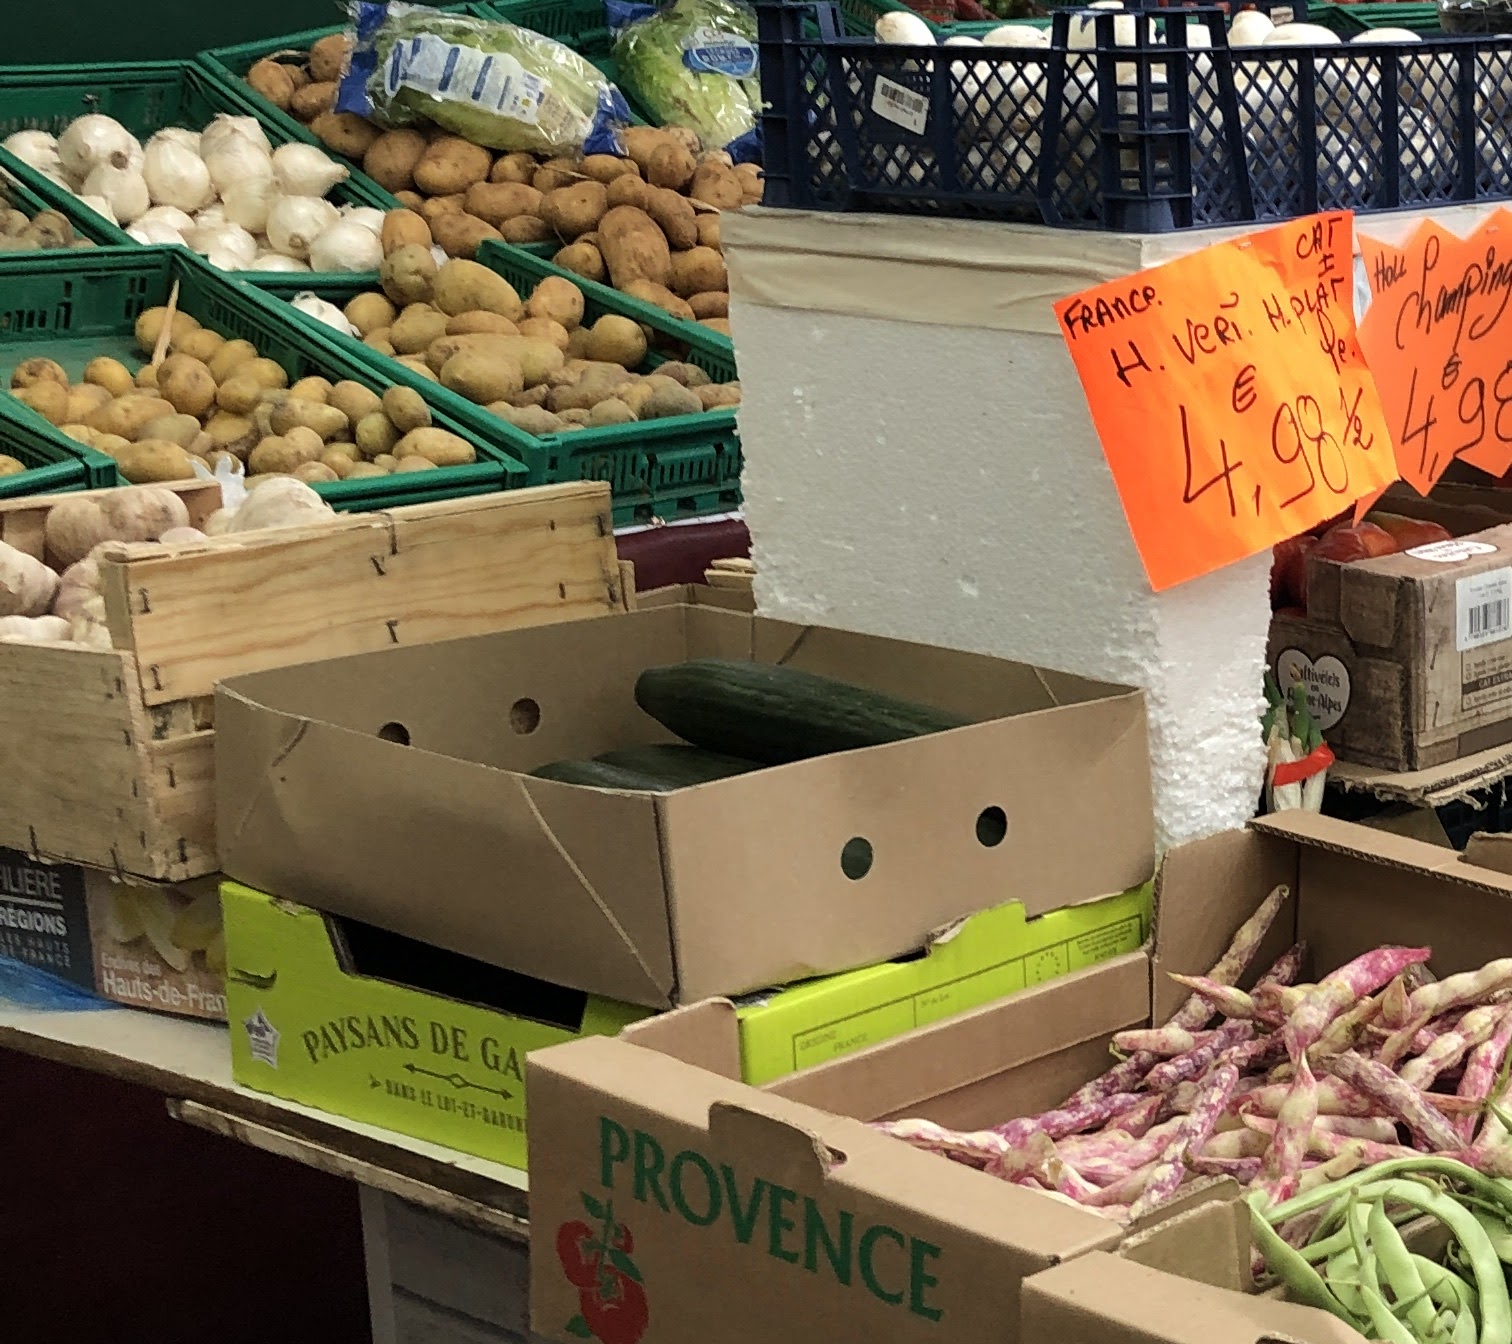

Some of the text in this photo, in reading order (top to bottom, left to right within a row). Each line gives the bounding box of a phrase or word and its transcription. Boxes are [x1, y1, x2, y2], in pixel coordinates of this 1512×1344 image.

[303, 1015, 420, 1065] PAYSANS
[430, 1021, 471, 1064] DE
[599, 1114, 945, 1323] PROVENCE
